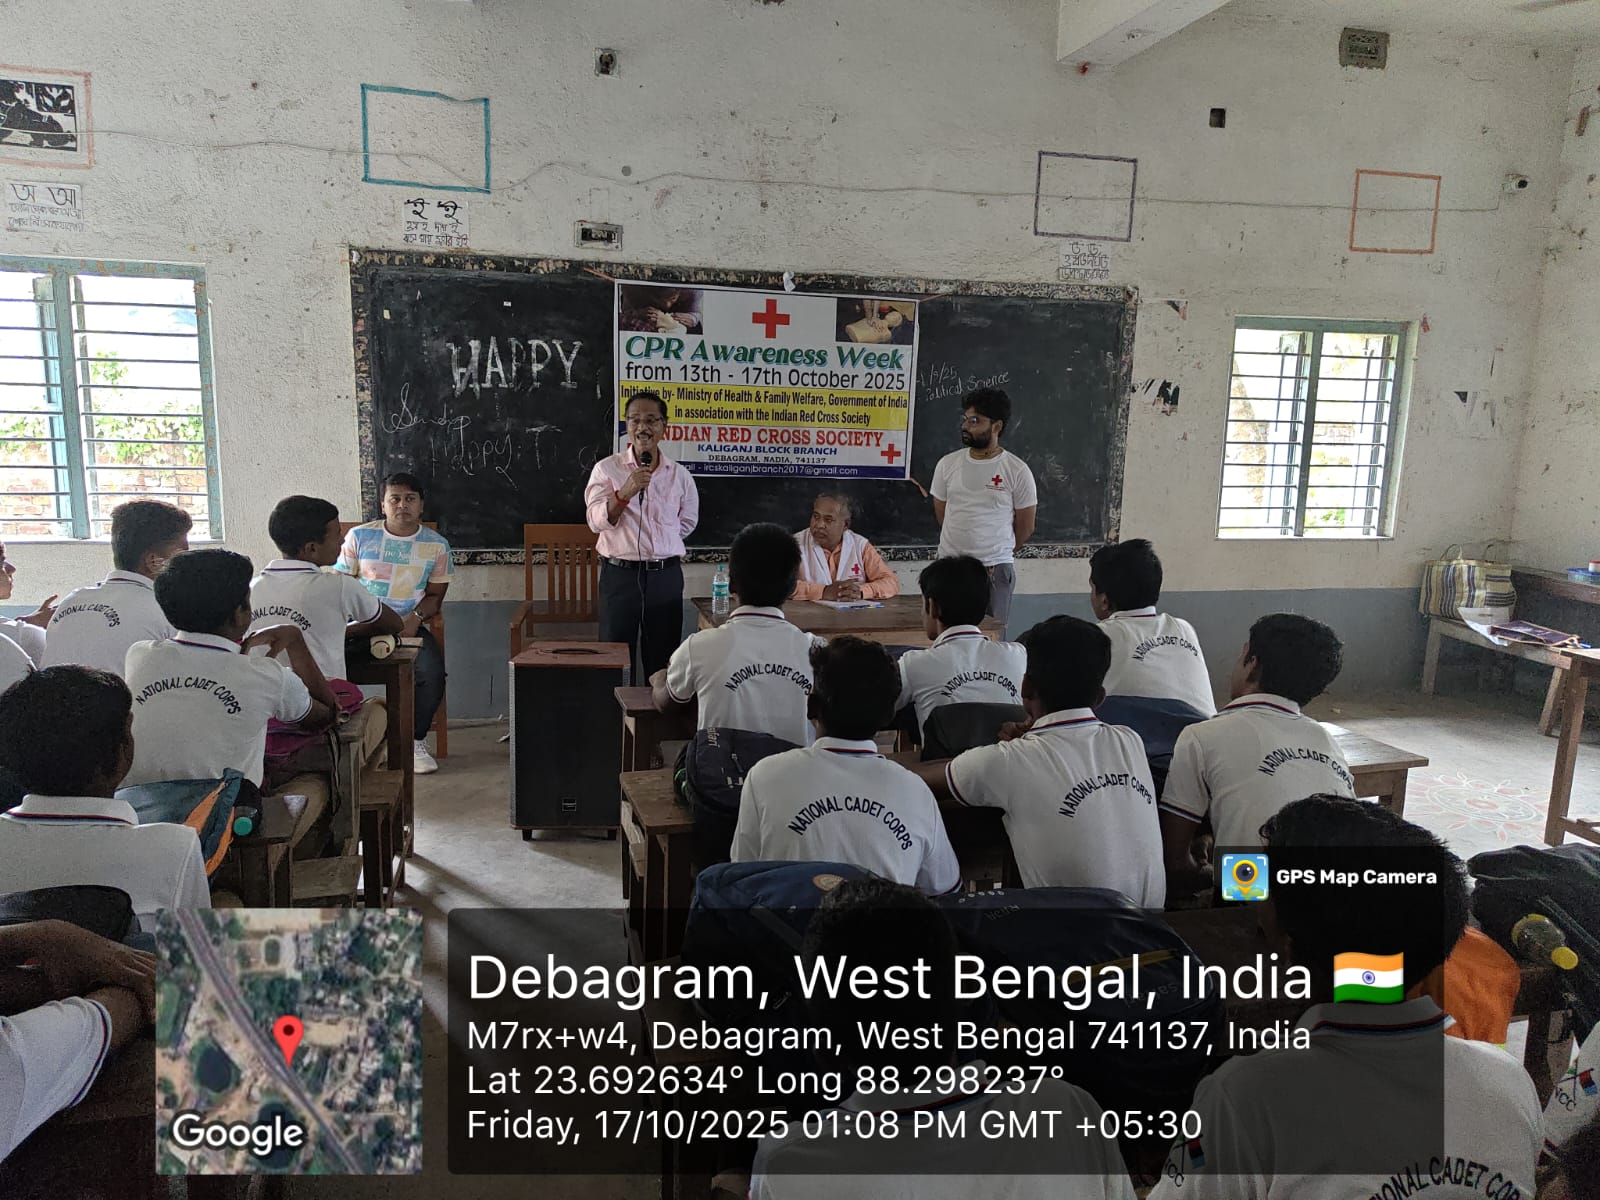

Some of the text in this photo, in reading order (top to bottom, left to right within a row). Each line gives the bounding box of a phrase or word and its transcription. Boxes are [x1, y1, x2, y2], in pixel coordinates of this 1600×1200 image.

[445, 336, 583, 396] HAPPY
[625, 335, 686, 362] CPR
[836, 345, 904, 371] Week
[625, 361, 672, 381] from
[680, 364, 721, 383] 13th
[741, 367, 782, 385] 17th
[788, 369, 859, 388] October
[864, 372, 905, 391] 2025
[677, 388, 712, 404] Ministry
[713, 388, 724, 401] of
[724, 389, 753, 403] Health
[754, 391, 762, 403] &
[764, 391, 791, 407] Family
[792, 391, 827, 408] Welfare,
[828, 393, 877, 409] Government
[878, 395, 888, 408] of
[888, 395, 908, 409] India
[674, 405, 871, 427] in association with the Indian Red Cross Society
[660, 425, 884, 447] NDIAN RED CROSS SOCIETY
[697, 444, 837, 455] KALIGANJ BLOCK BRANCH
[53, 604, 87, 625] NATIONAL
[269, 605, 293, 617] CADET
[290, 611, 312, 631] CORPS
[724, 663, 764, 692] NATIONAL
[764, 663, 793, 677] CADET
[940, 671, 1018, 698] NATIONAL CADET CORPS
[135, 676, 242, 715] NATIONAL CADET CORPS
[1258, 747, 1301, 777] NATIONAL
[1298, 748, 1330, 763] CADET
[1058, 773, 1153, 818] NATIONAL CADET CORPS
[787, 796, 913, 851] NATIONAL CADET CORPS
[1429, 1156, 1489, 1190] CADET
